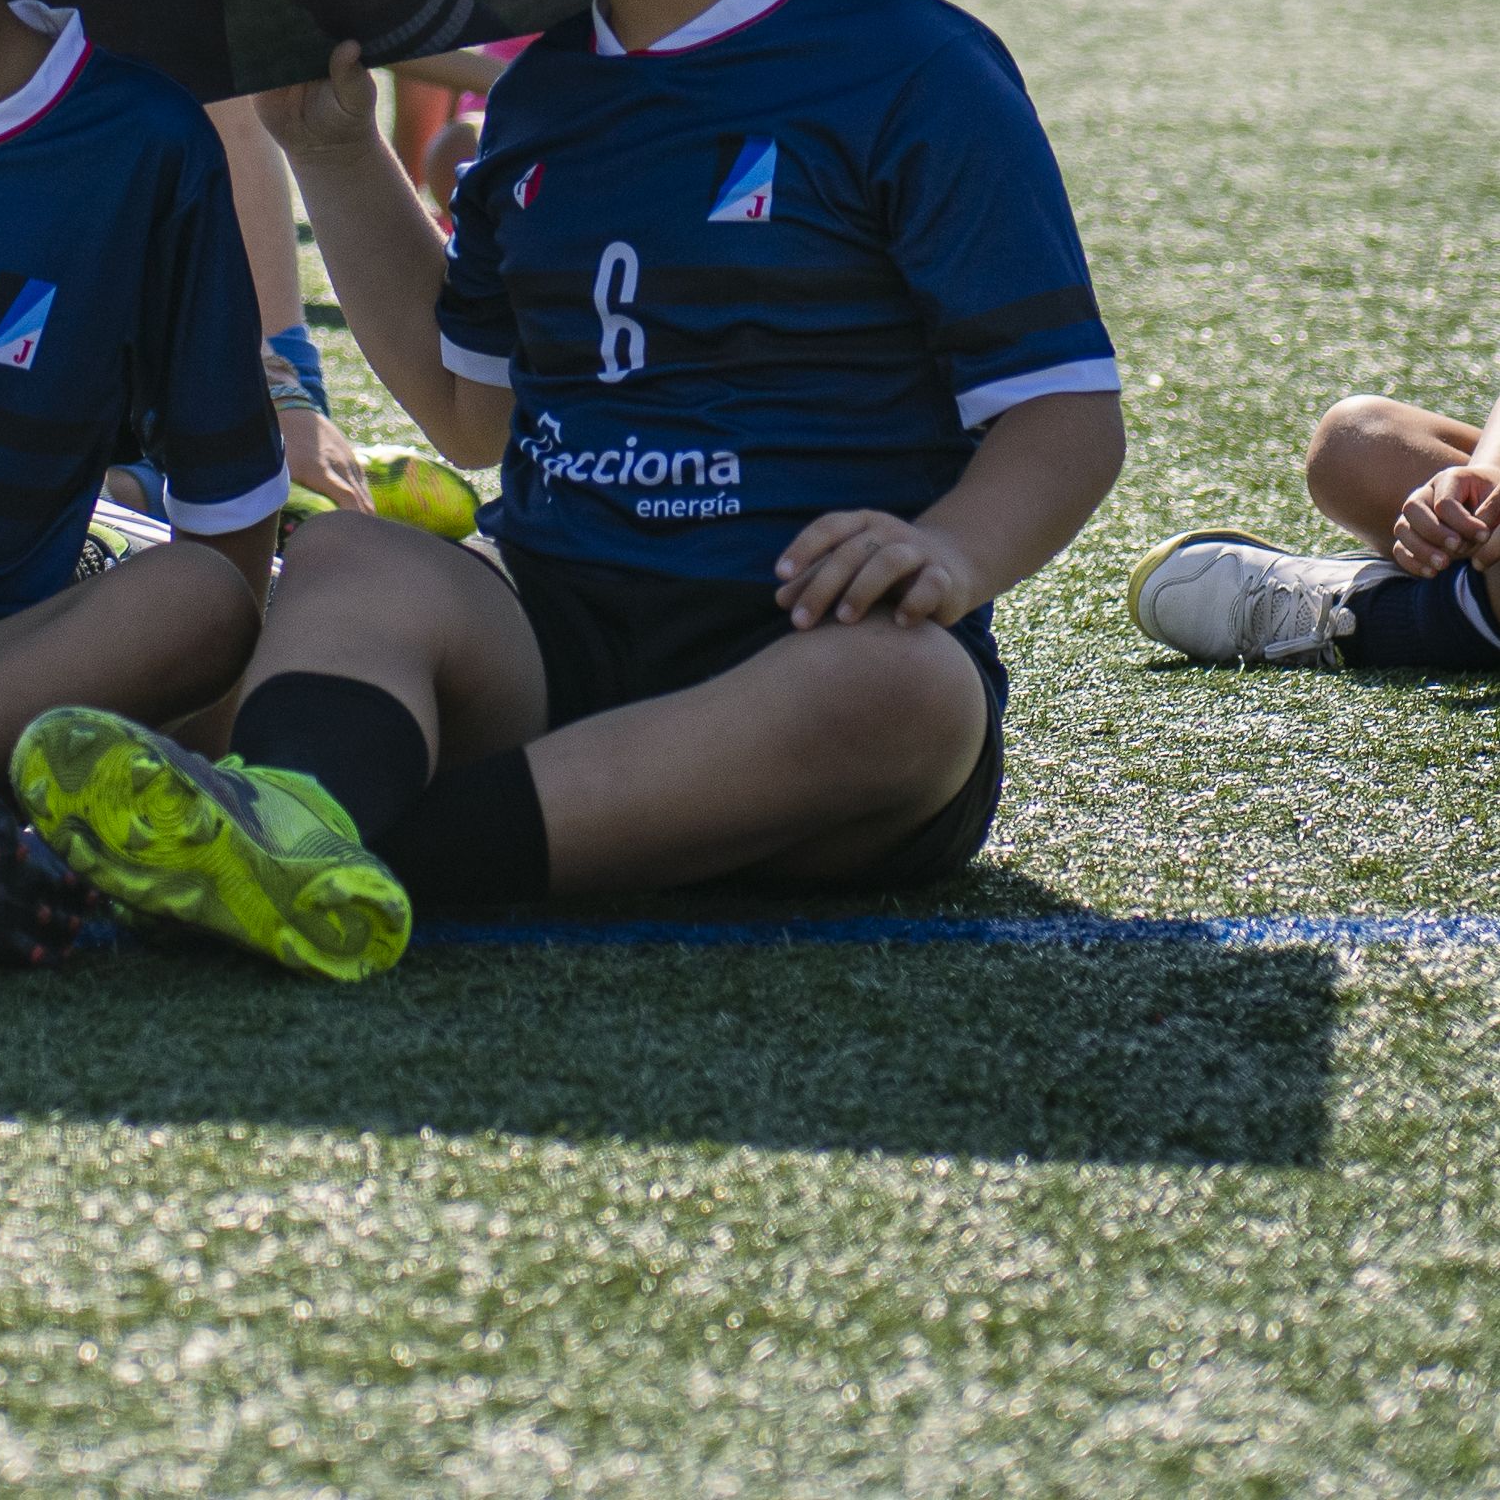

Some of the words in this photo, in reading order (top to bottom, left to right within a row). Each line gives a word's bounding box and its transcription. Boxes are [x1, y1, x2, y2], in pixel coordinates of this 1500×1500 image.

[746, 195, 767, 220] J
[594, 240, 645, 384] 6
[13, 339, 34, 365] J
[542, 435, 741, 488] acciona
[636, 491, 741, 519] energía
